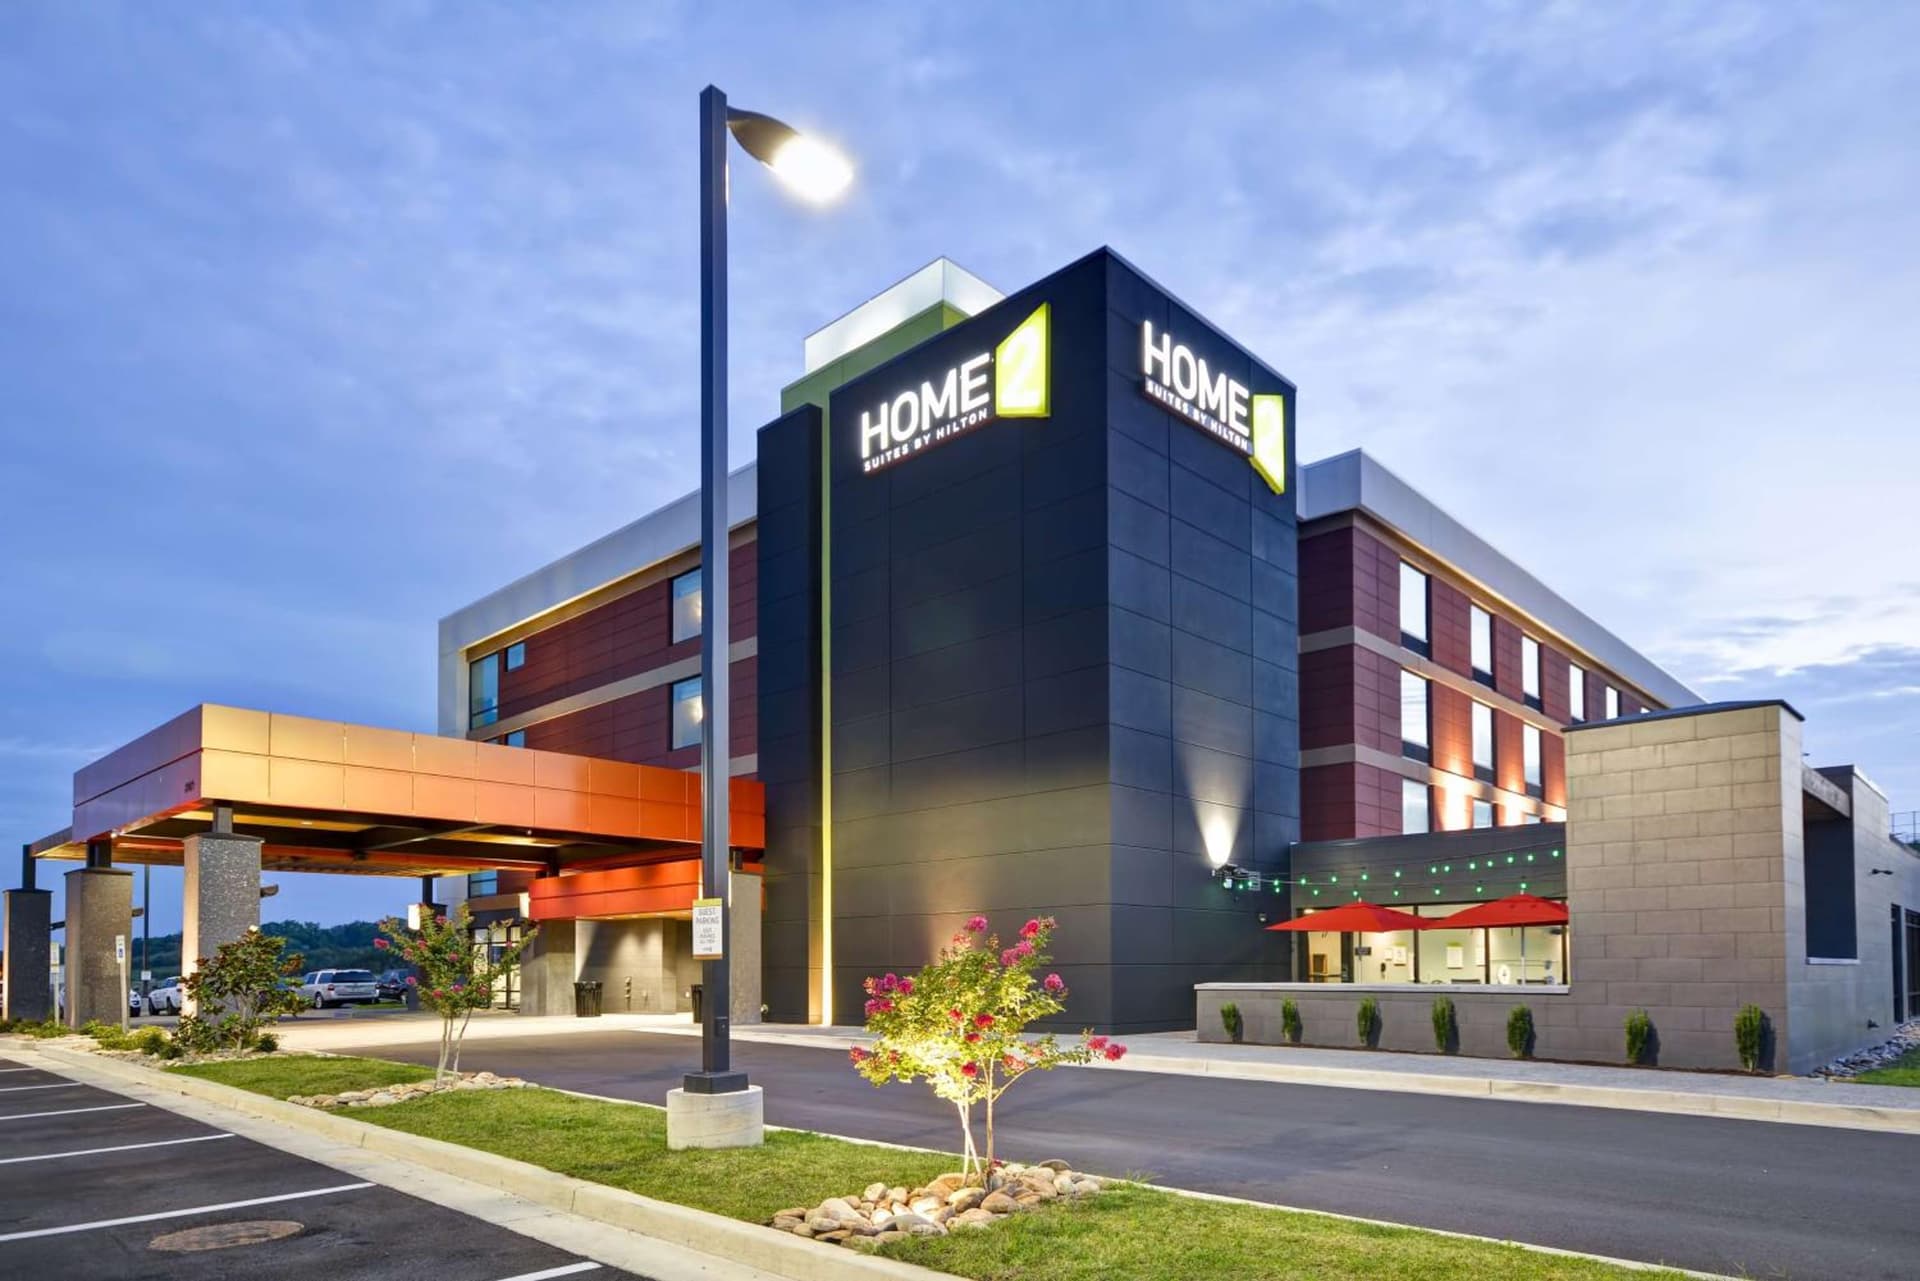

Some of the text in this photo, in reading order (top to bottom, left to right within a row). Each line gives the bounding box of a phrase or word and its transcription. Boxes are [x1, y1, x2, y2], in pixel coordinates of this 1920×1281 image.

[861, 324, 1041, 459] HOME 2
[1143, 319, 1249, 437] HOME
[1145, 380, 1248, 450] SUITES BY HILTON
[864, 407, 987, 472] SUITES BY HILTON
